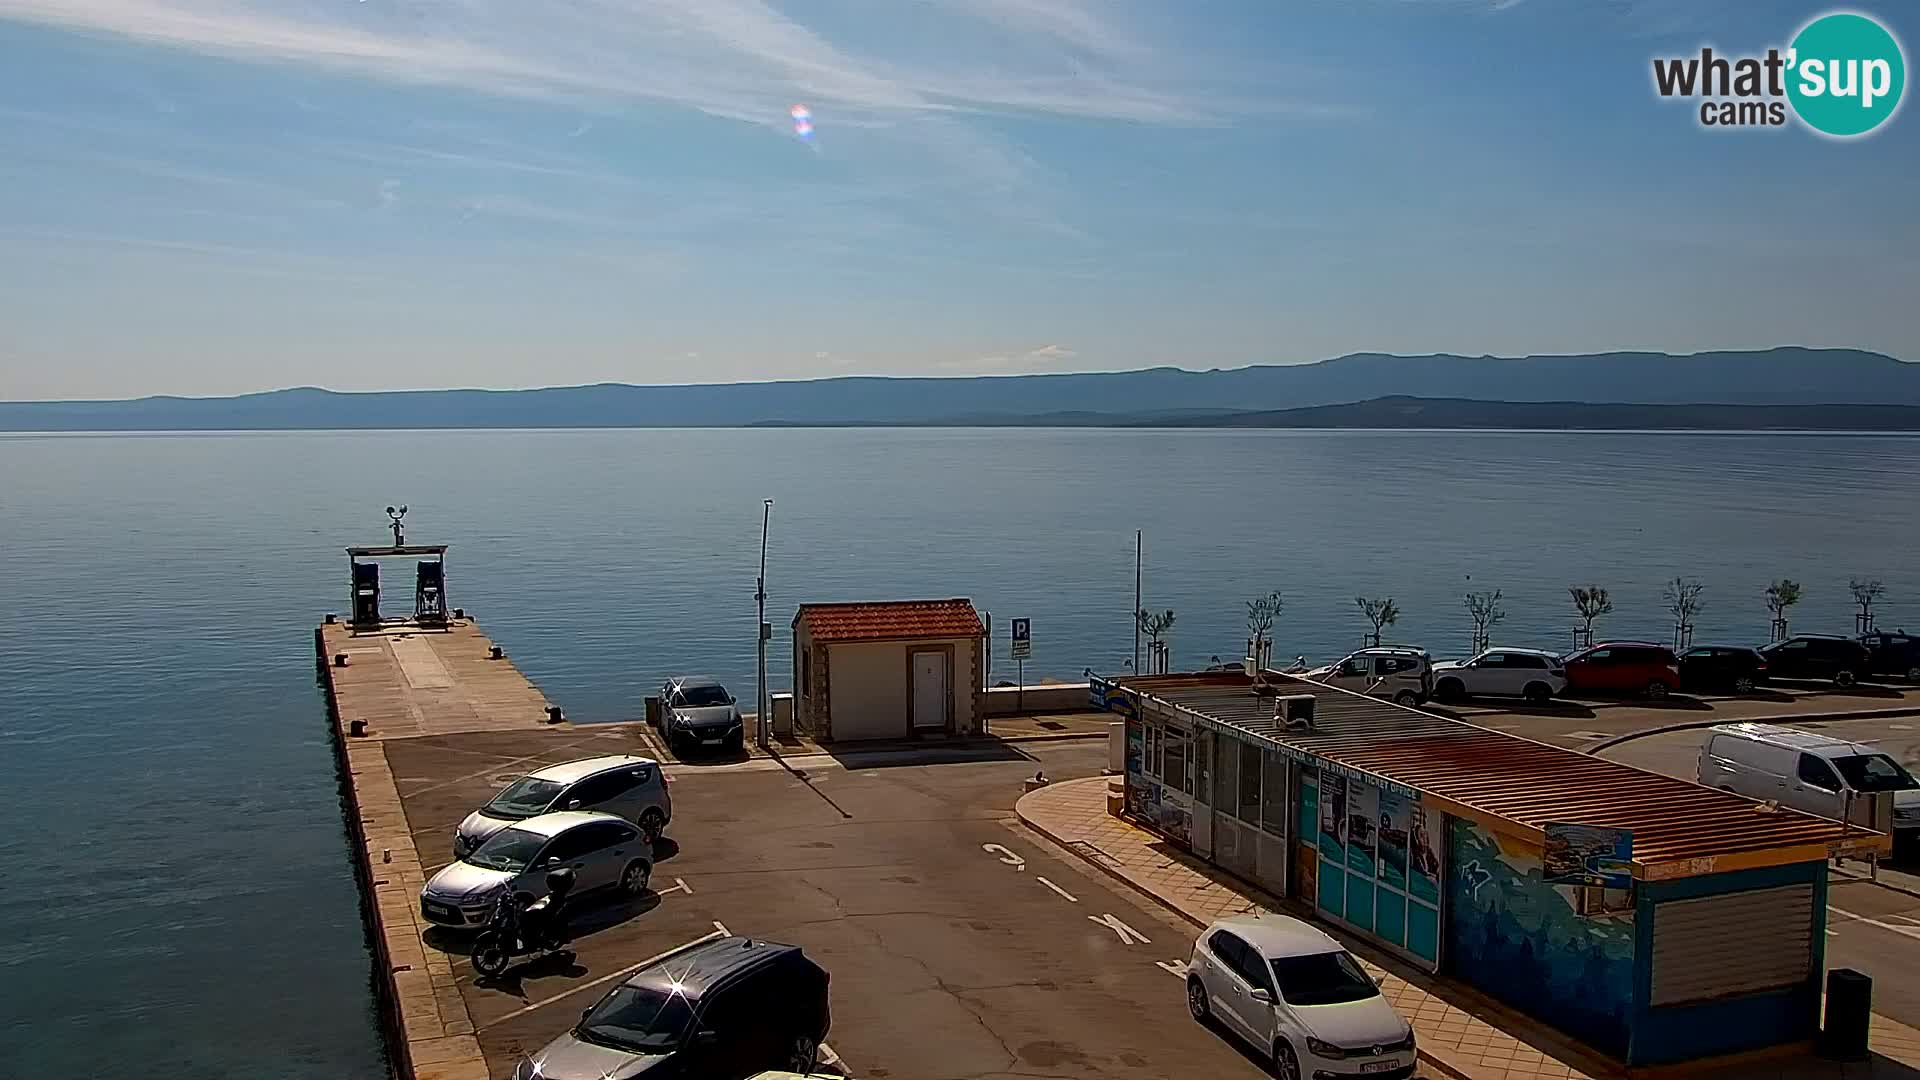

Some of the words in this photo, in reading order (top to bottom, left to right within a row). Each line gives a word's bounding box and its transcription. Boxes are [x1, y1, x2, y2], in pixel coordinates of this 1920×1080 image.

[1016, 621, 1026, 637] P
[1315, 758, 1329, 770] BUS
[1330, 762, 1361, 780] STATION
[1364, 772, 1388, 790] TICKET
[1390, 784, 1417, 800] OFFICE
